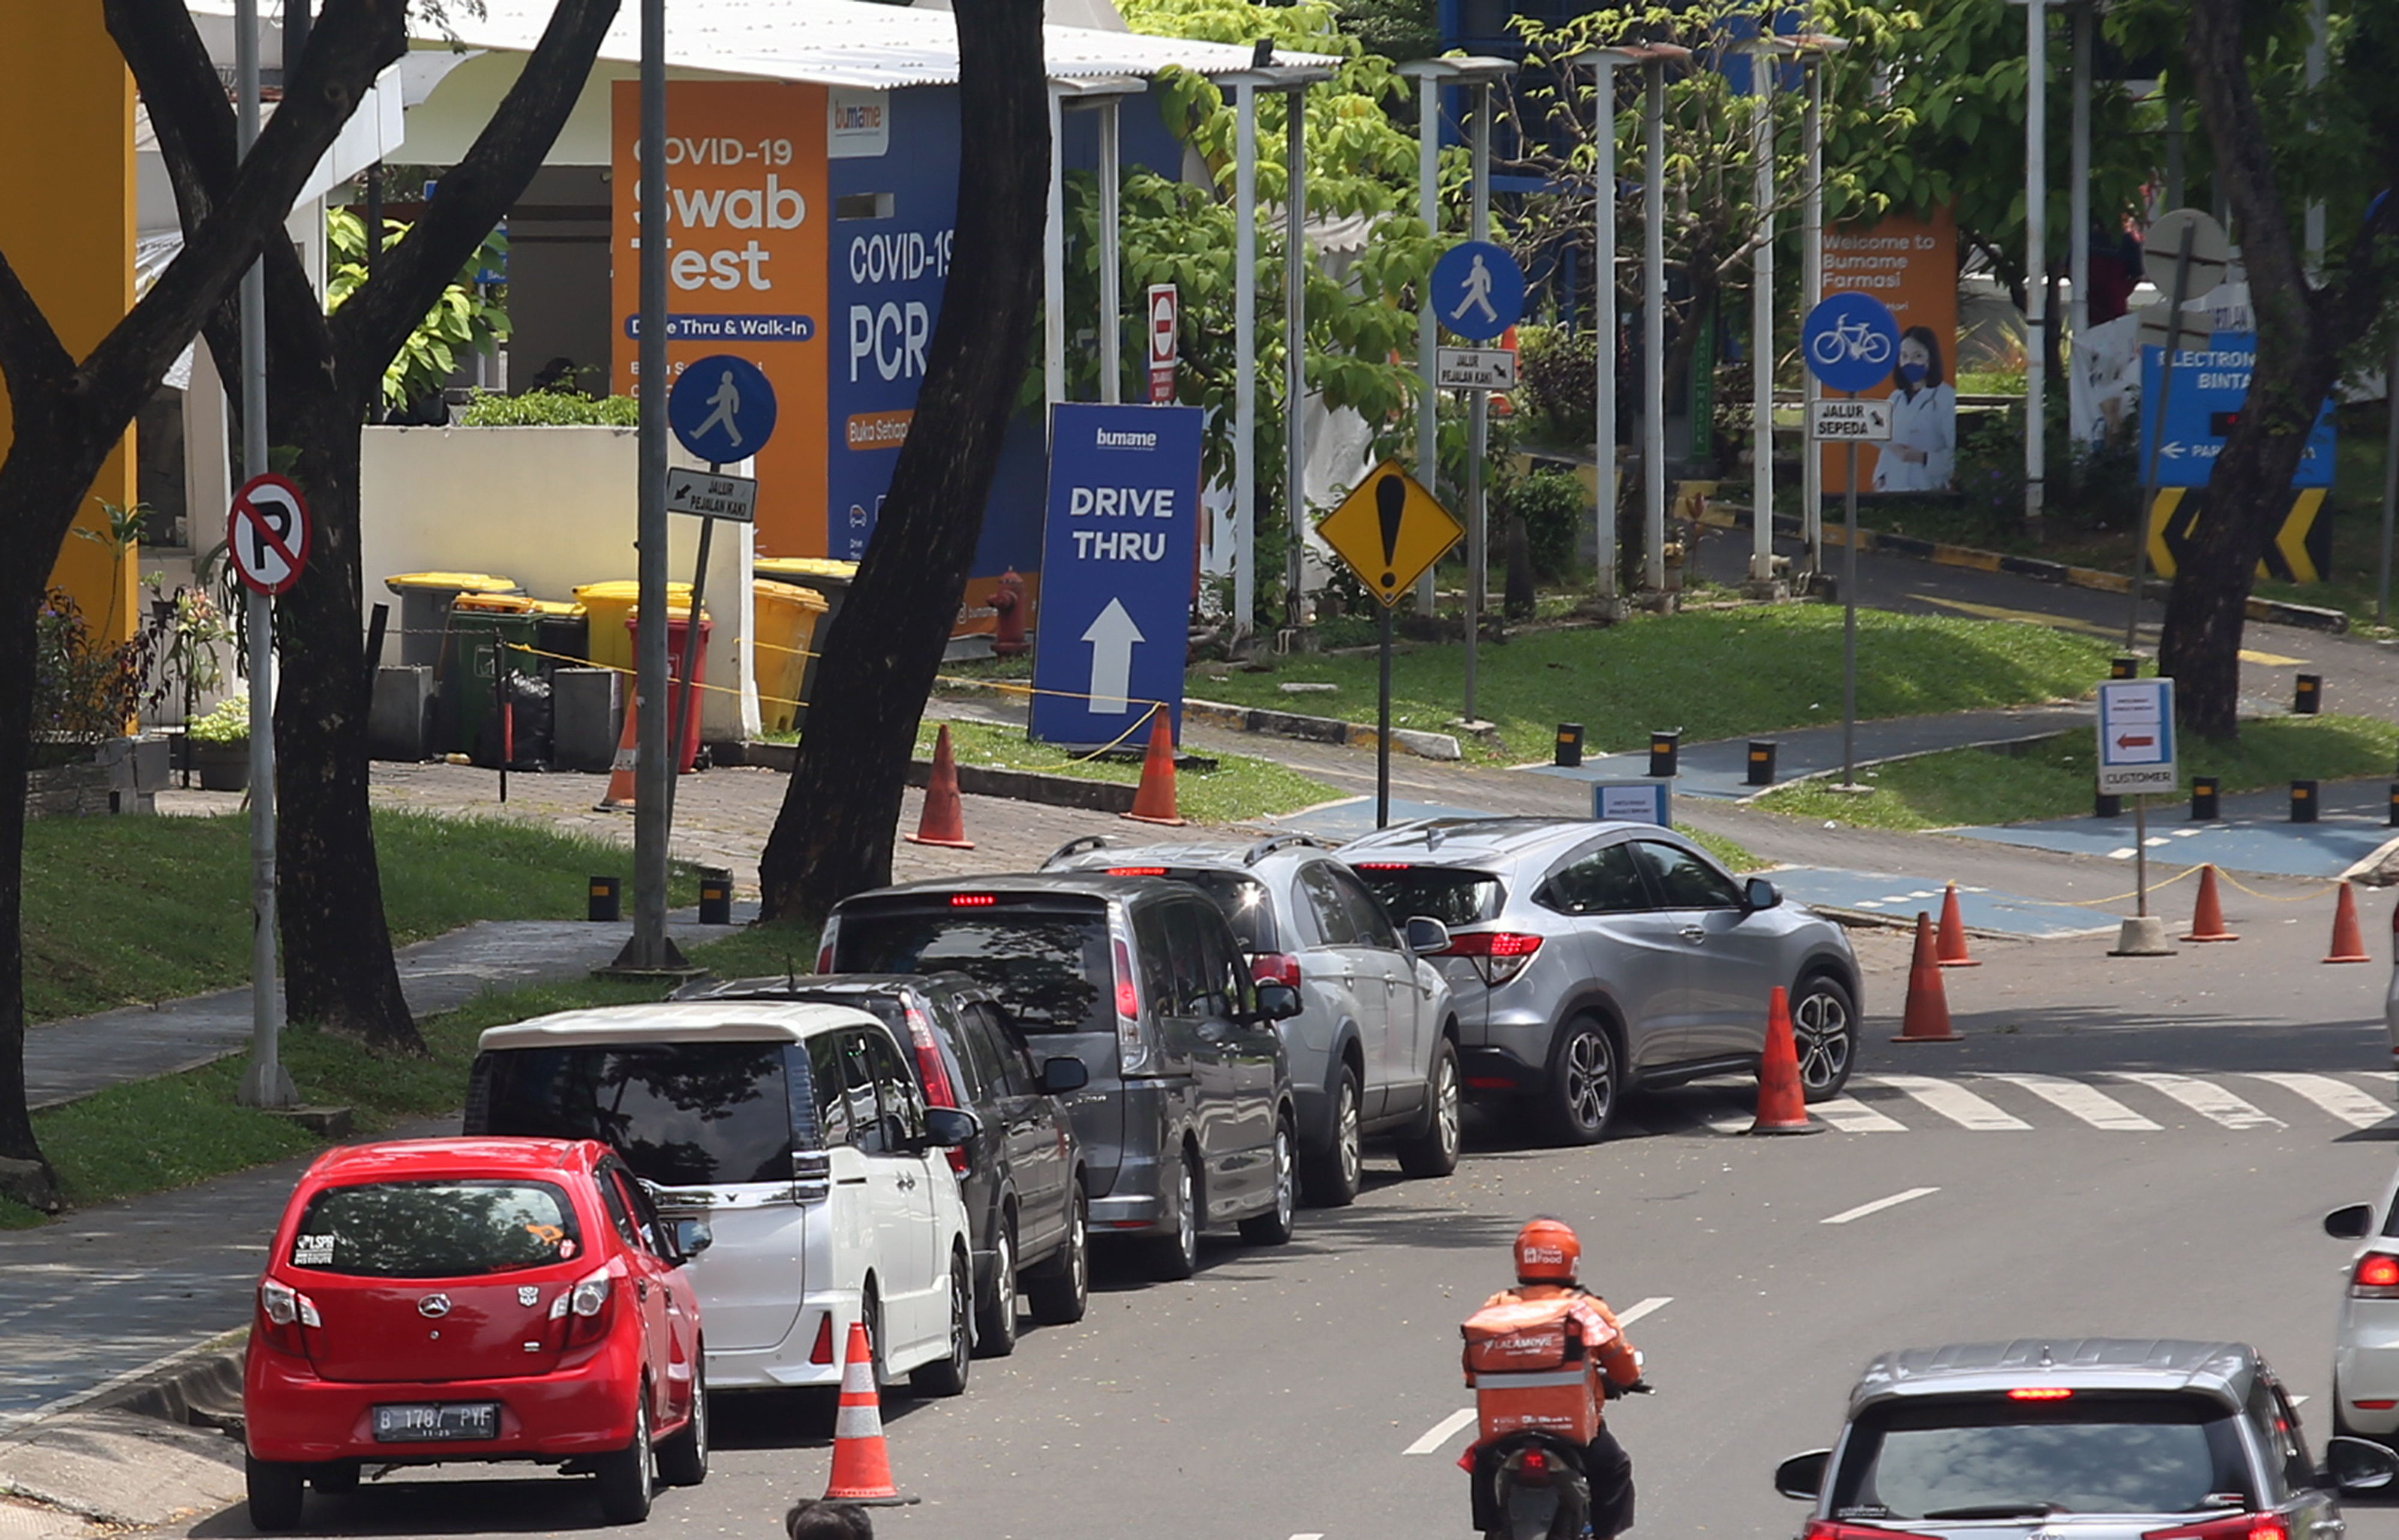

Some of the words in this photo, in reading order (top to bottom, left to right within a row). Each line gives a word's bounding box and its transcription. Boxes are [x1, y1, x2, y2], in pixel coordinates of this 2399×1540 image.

[835, 99, 881, 130] bumame
[1823, 234, 1910, 250] Welcome
[1915, 234, 1935, 250] to
[1823, 253, 1909, 270] Bumame
[1823, 271, 1902, 288] Farmasi
[681, 319, 720, 335] Thru
[724, 320, 738, 335] &
[740, 320, 807, 336] Walk-In
[850, 301, 930, 383] PCR
[1456, 354, 1479, 368] JALUR
[2157, 351, 2257, 368] ELECTRON
[1441, 369, 1474, 383] PEJALAN
[1475, 371, 1493, 384] KAKI
[2197, 372, 2251, 389] BINTA
[1822, 404, 1865, 419] JALUR
[849, 420, 875, 443] Buka
[876, 418, 909, 442] Setiap
[1818, 421, 1869, 435] SEPEDA
[1097, 428, 1157, 446] bumame
[708, 480, 735, 497] JALUR
[690, 494, 724, 512] PEJALAN
[726, 500, 747, 517] KAKI
[1069, 487, 1175, 518] DRIVE
[1072, 531, 1167, 562] THRU
[2106, 771, 2172, 785] CUSTOMER
[380, 1410, 390, 1429] B
[459, 1407, 491, 1427] PYF
